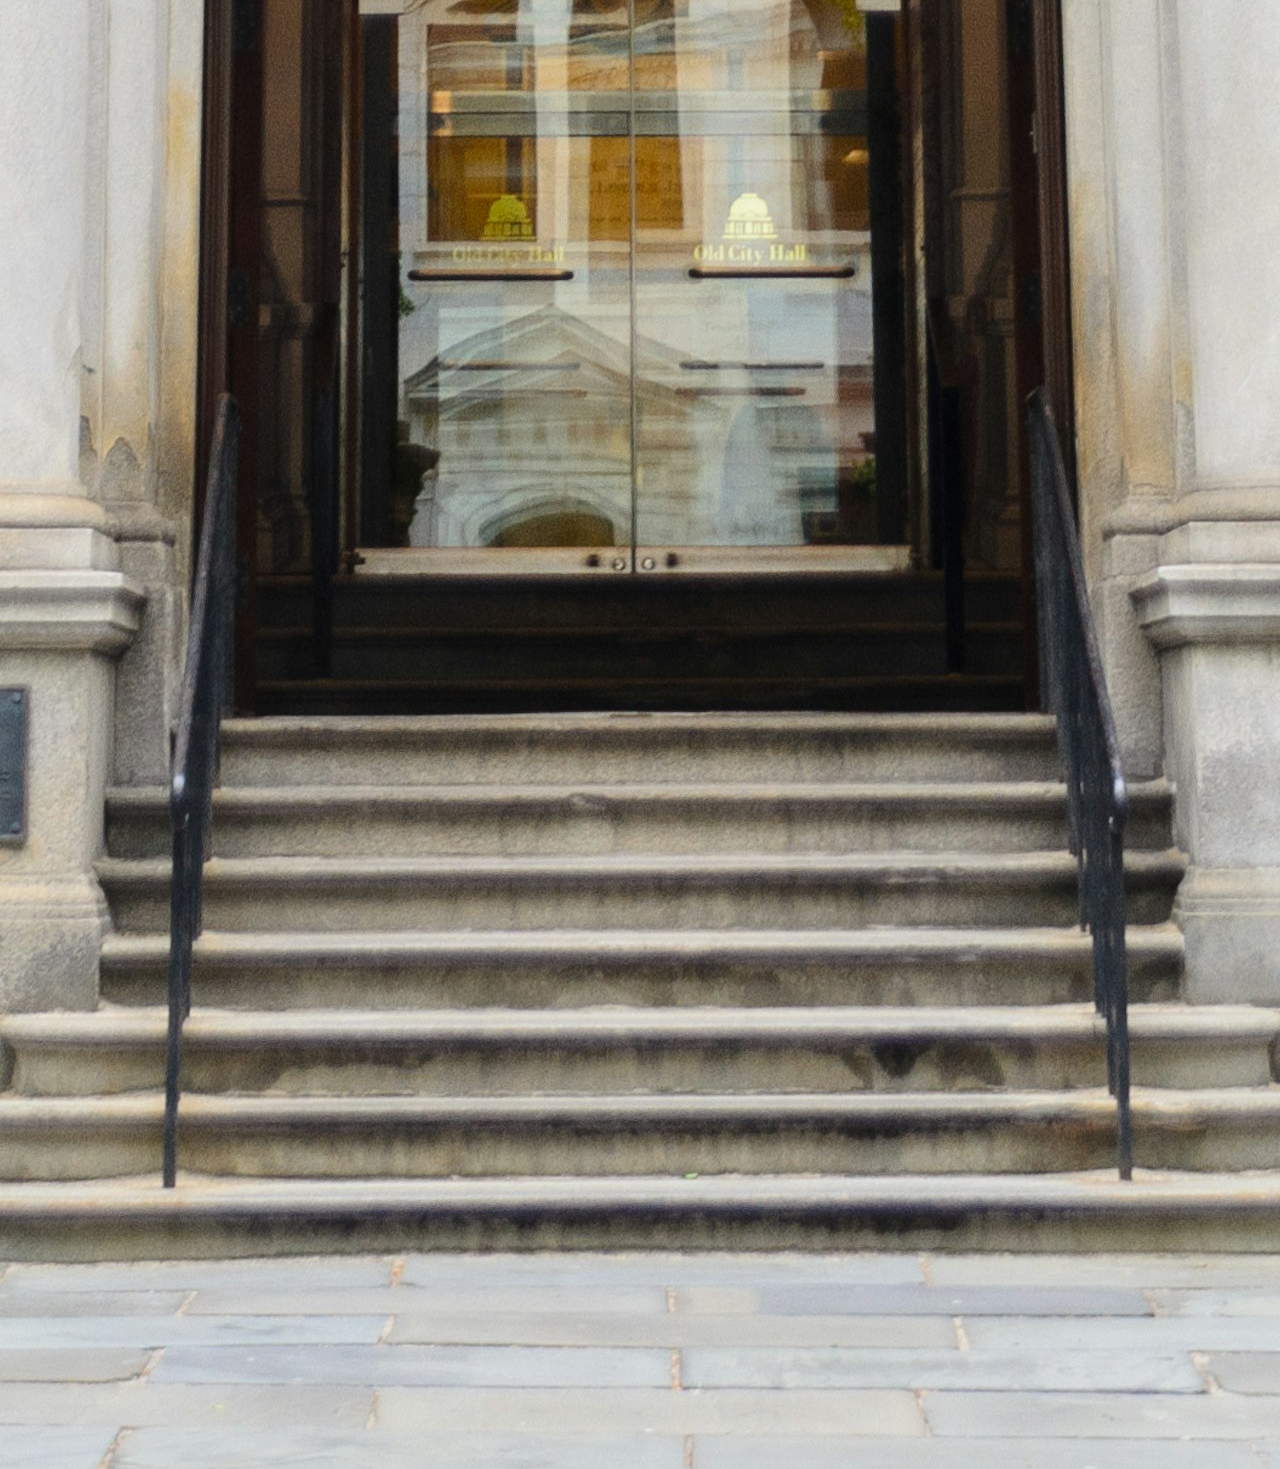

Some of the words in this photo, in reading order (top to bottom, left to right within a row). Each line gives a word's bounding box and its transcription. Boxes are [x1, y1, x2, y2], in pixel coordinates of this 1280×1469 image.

[528, 245, 565, 262] Hall
[693, 244, 724, 262] Old
[728, 244, 765, 267] City
[769, 243, 806, 261] Hall
